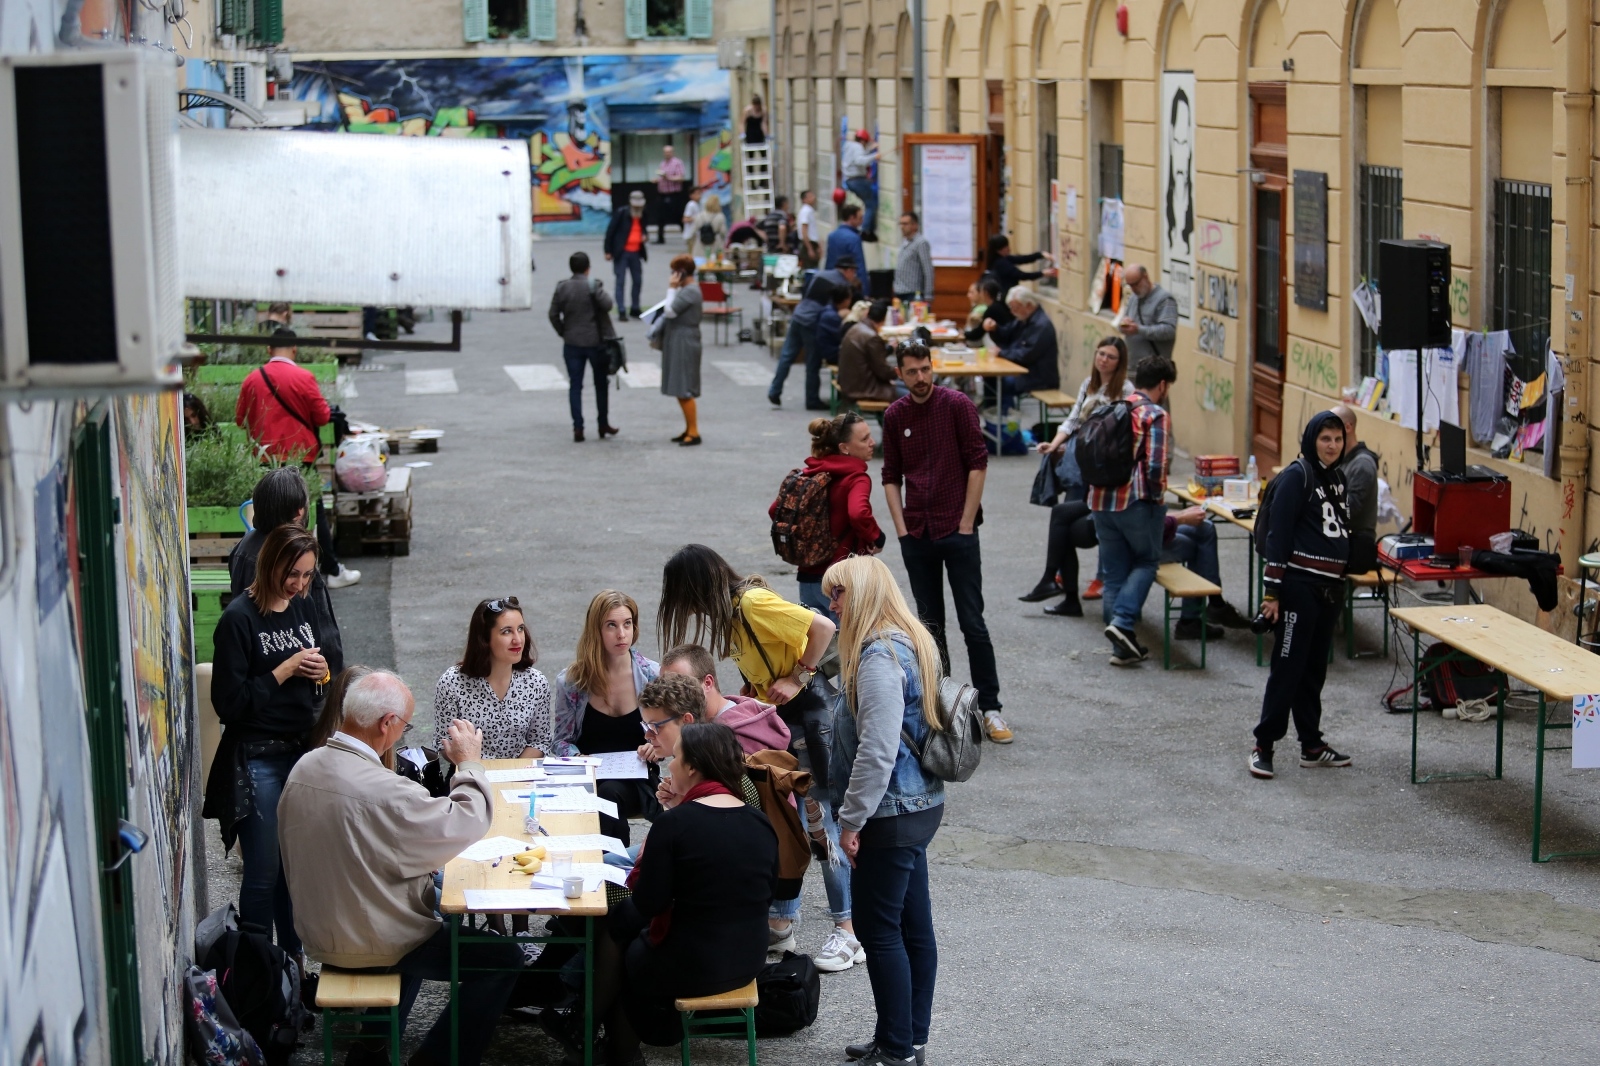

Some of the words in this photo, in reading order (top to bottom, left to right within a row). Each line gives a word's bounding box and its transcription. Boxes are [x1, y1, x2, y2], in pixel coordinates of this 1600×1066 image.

[1284, 610, 1298, 624] 19
[259, 627, 304, 655] ROCK
[1280, 623, 1294, 658] TRAINING
